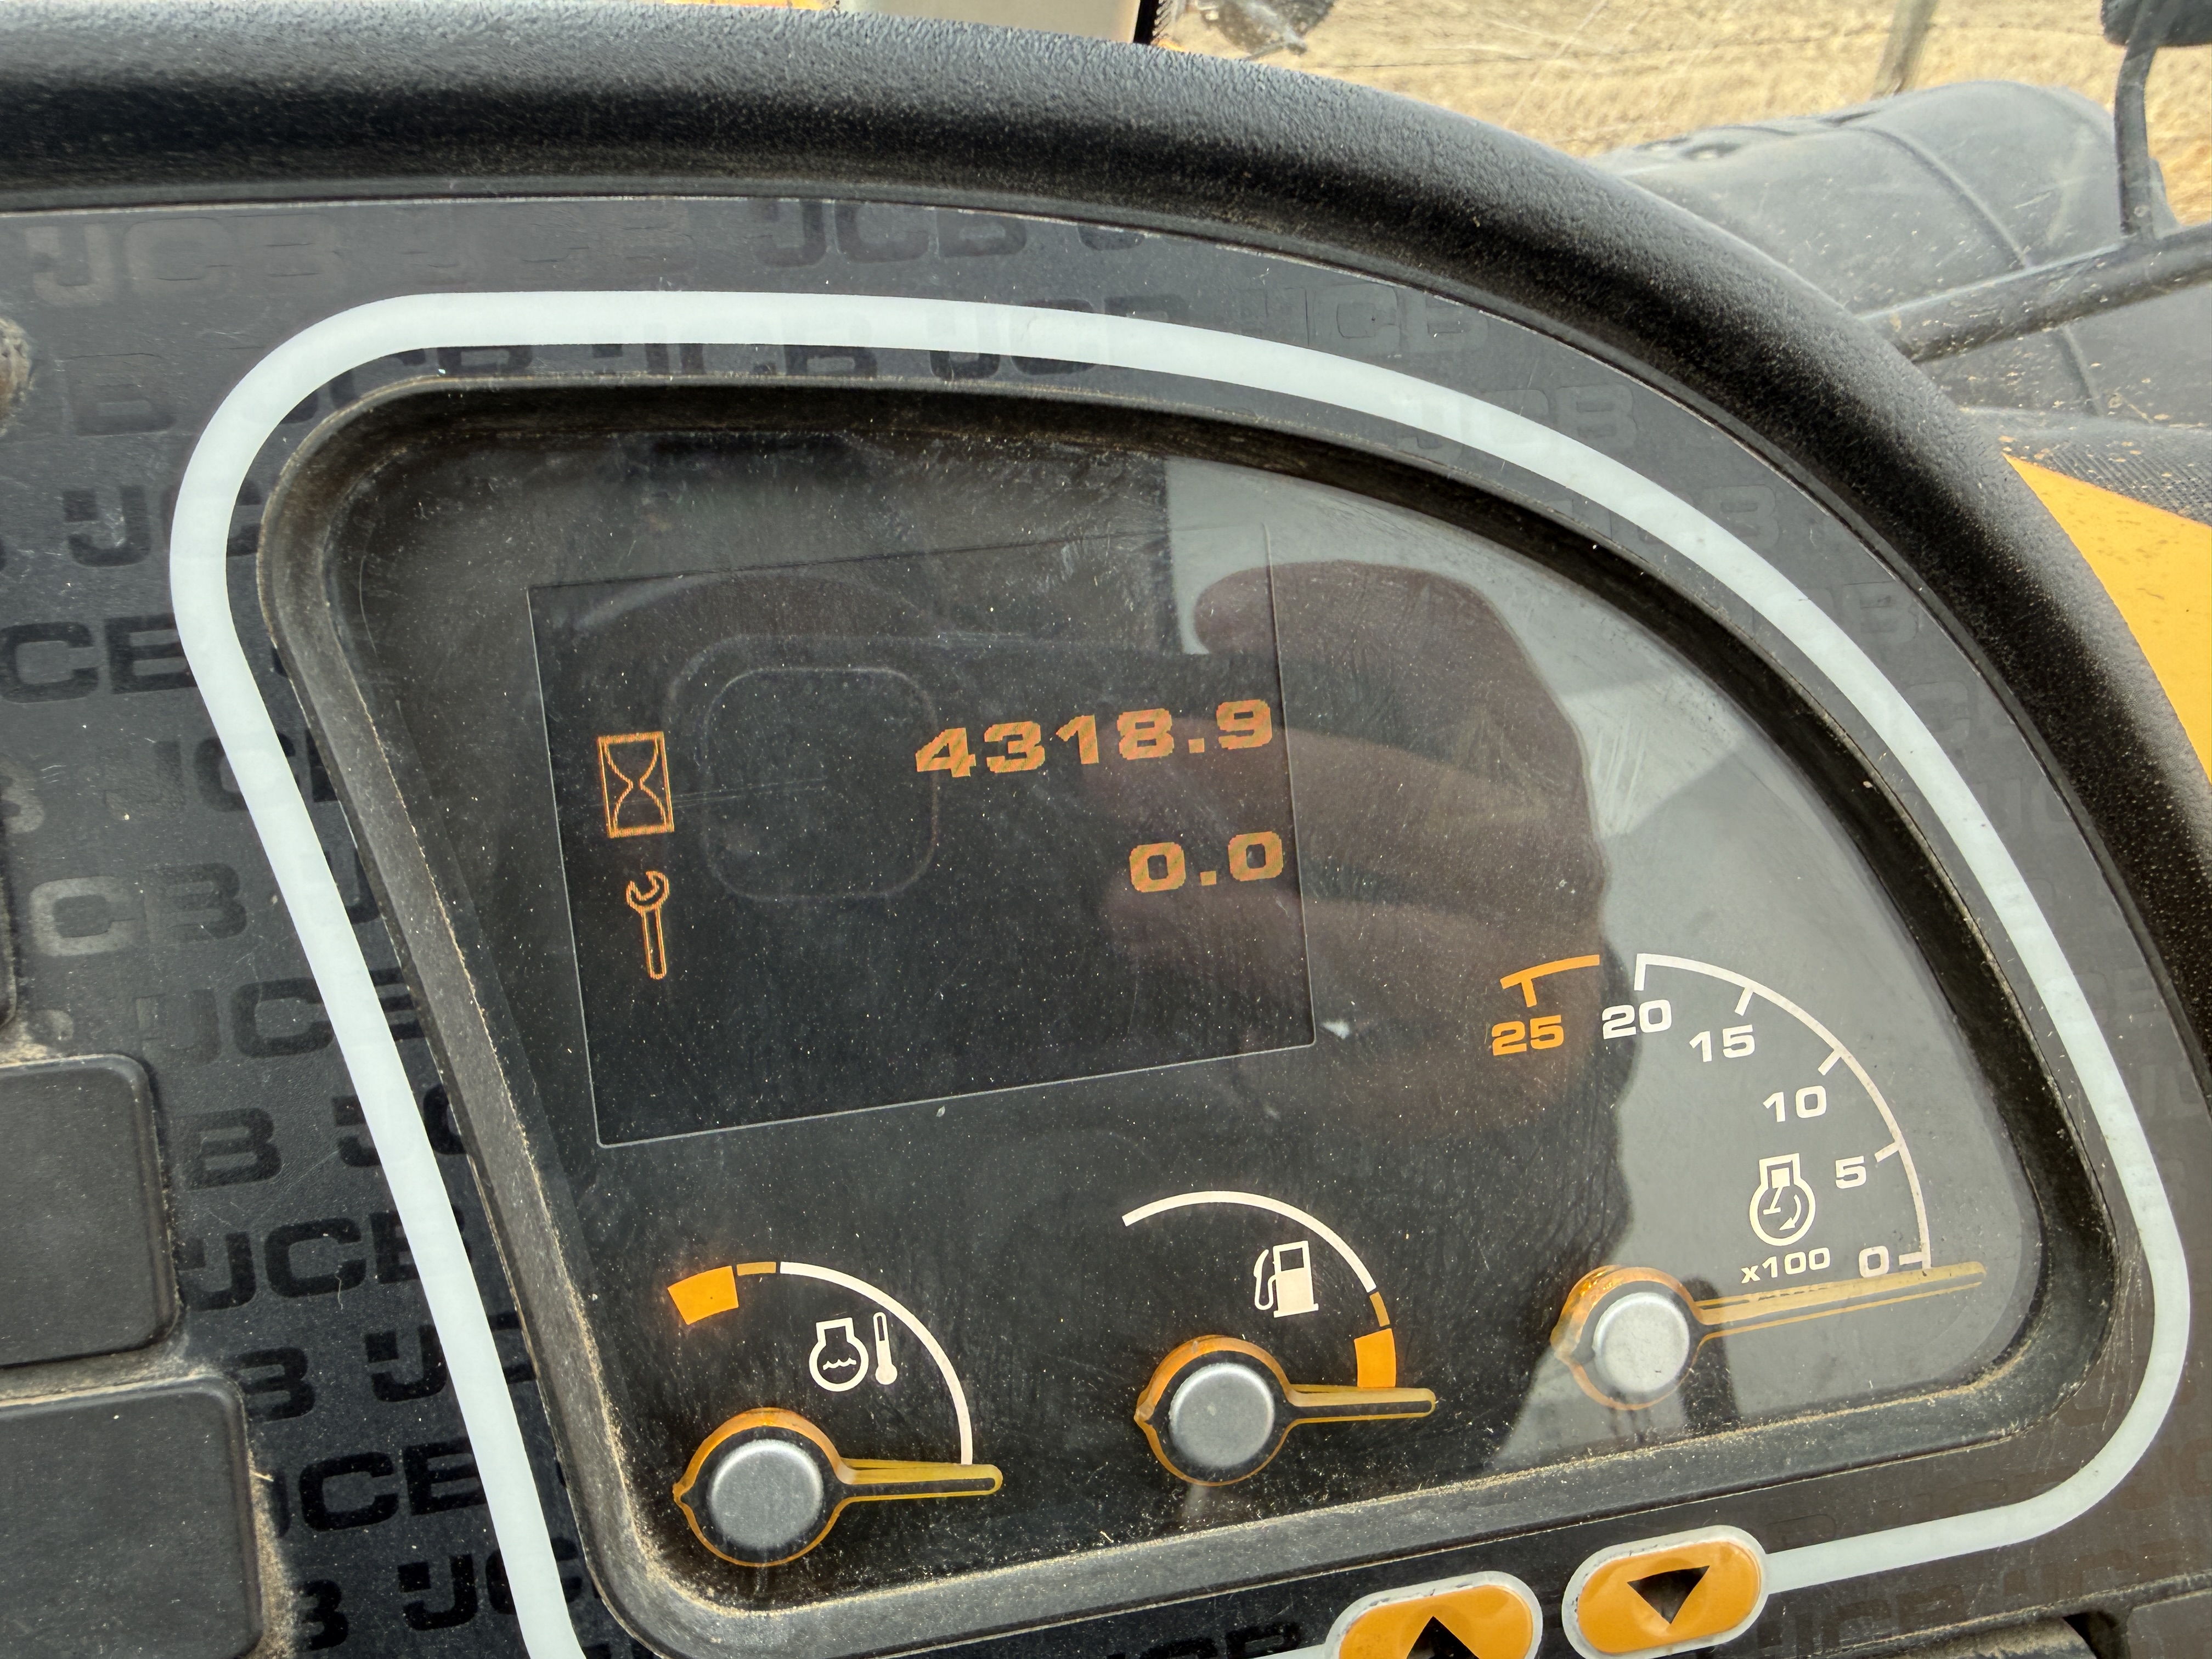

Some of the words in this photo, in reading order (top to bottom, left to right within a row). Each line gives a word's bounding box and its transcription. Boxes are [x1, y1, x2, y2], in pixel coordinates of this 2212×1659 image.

[915, 698, 1273, 778] 4318.9
[1129, 831, 1284, 893] 0.0
[1492, 1015, 1565, 1057] 25
[1601, 999, 1673, 1040] 20
[1689, 1024, 1756, 1063] 15
[1763, 1085, 1827, 1122] 10
[1835, 1155, 1867, 1189] 5
[1740, 1246, 1831, 1284] x100
[1858, 1245, 1891, 1278] 0
